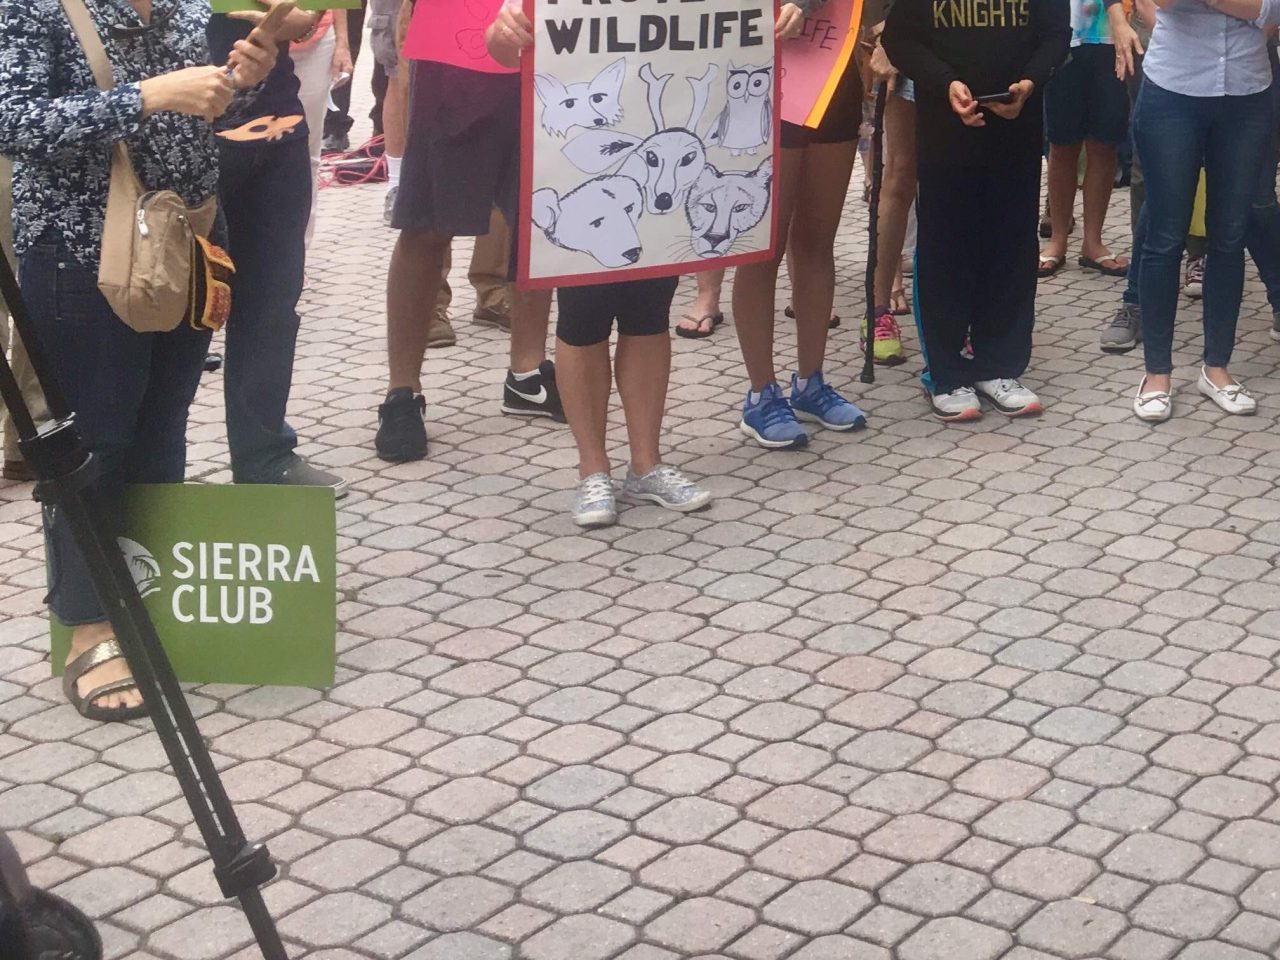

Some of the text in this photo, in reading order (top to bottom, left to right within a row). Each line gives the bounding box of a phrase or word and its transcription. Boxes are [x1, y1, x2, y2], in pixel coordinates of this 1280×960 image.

[545, 8, 763, 55] WILDLIFE
[792, 17, 838, 50] IFE
[171, 541, 321, 583] SIERRA
[171, 584, 274, 625] CLUB
